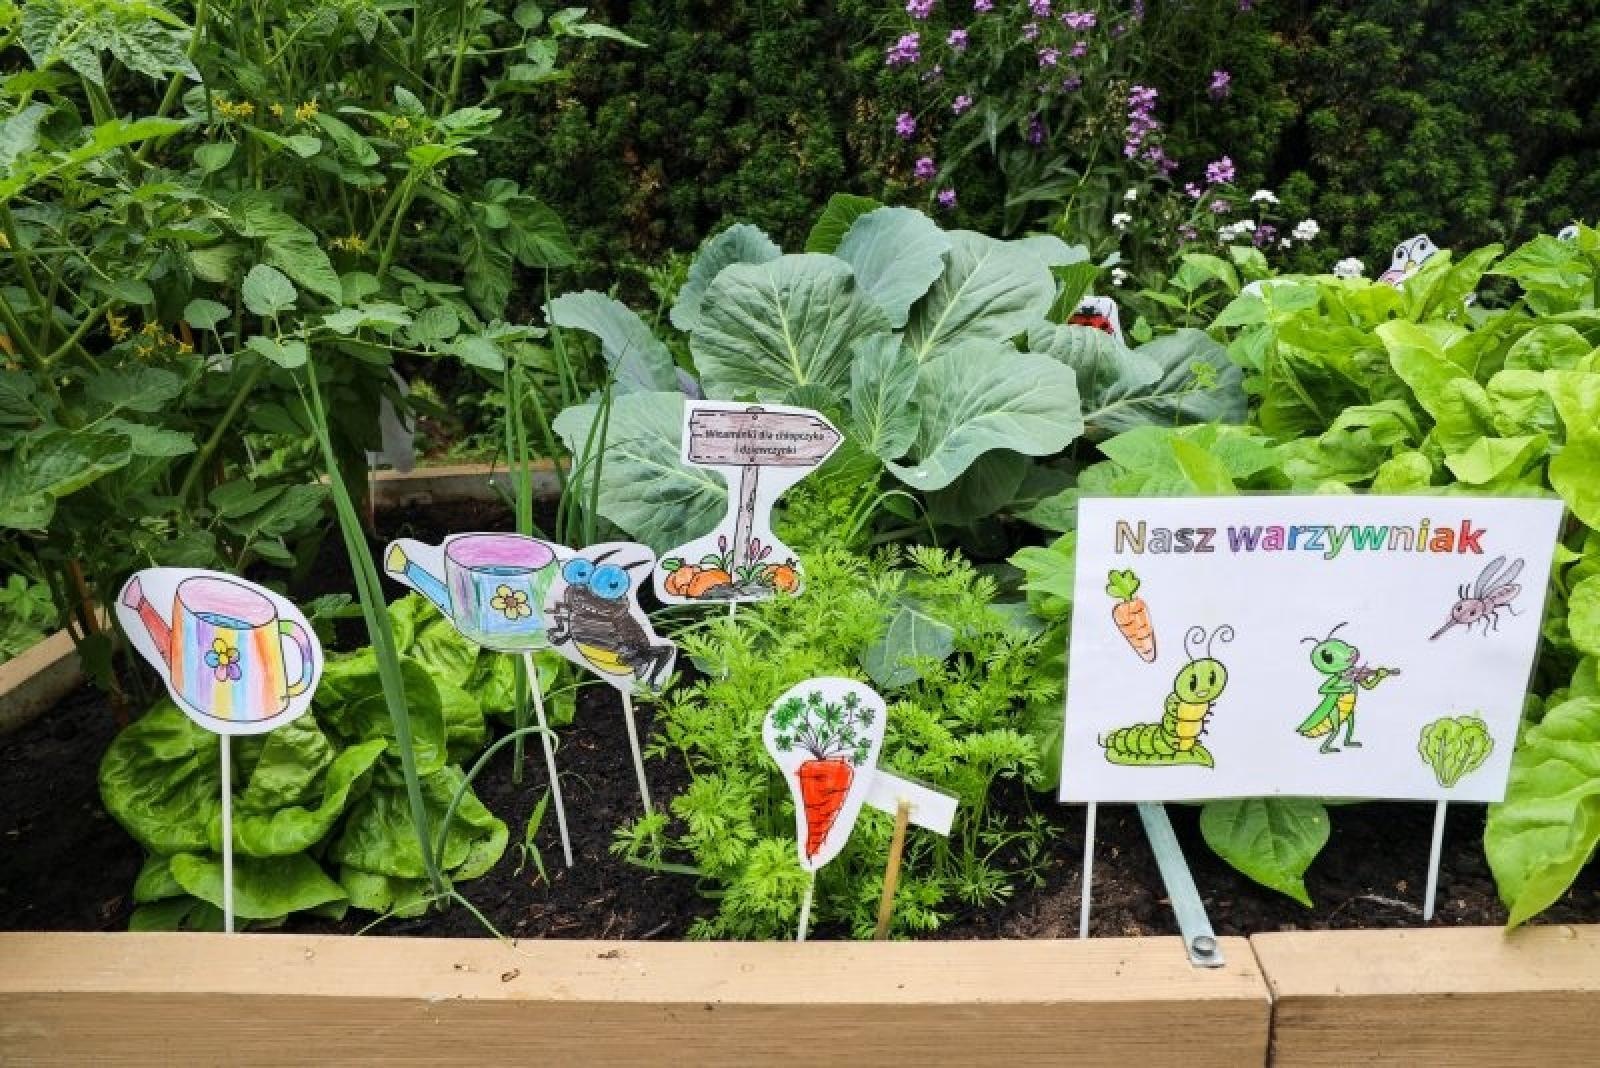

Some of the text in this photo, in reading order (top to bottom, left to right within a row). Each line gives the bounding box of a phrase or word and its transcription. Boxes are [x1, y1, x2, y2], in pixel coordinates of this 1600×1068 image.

[758, 430, 772, 440] dla
[1114, 518, 1487, 560] Nasz warzywniak
